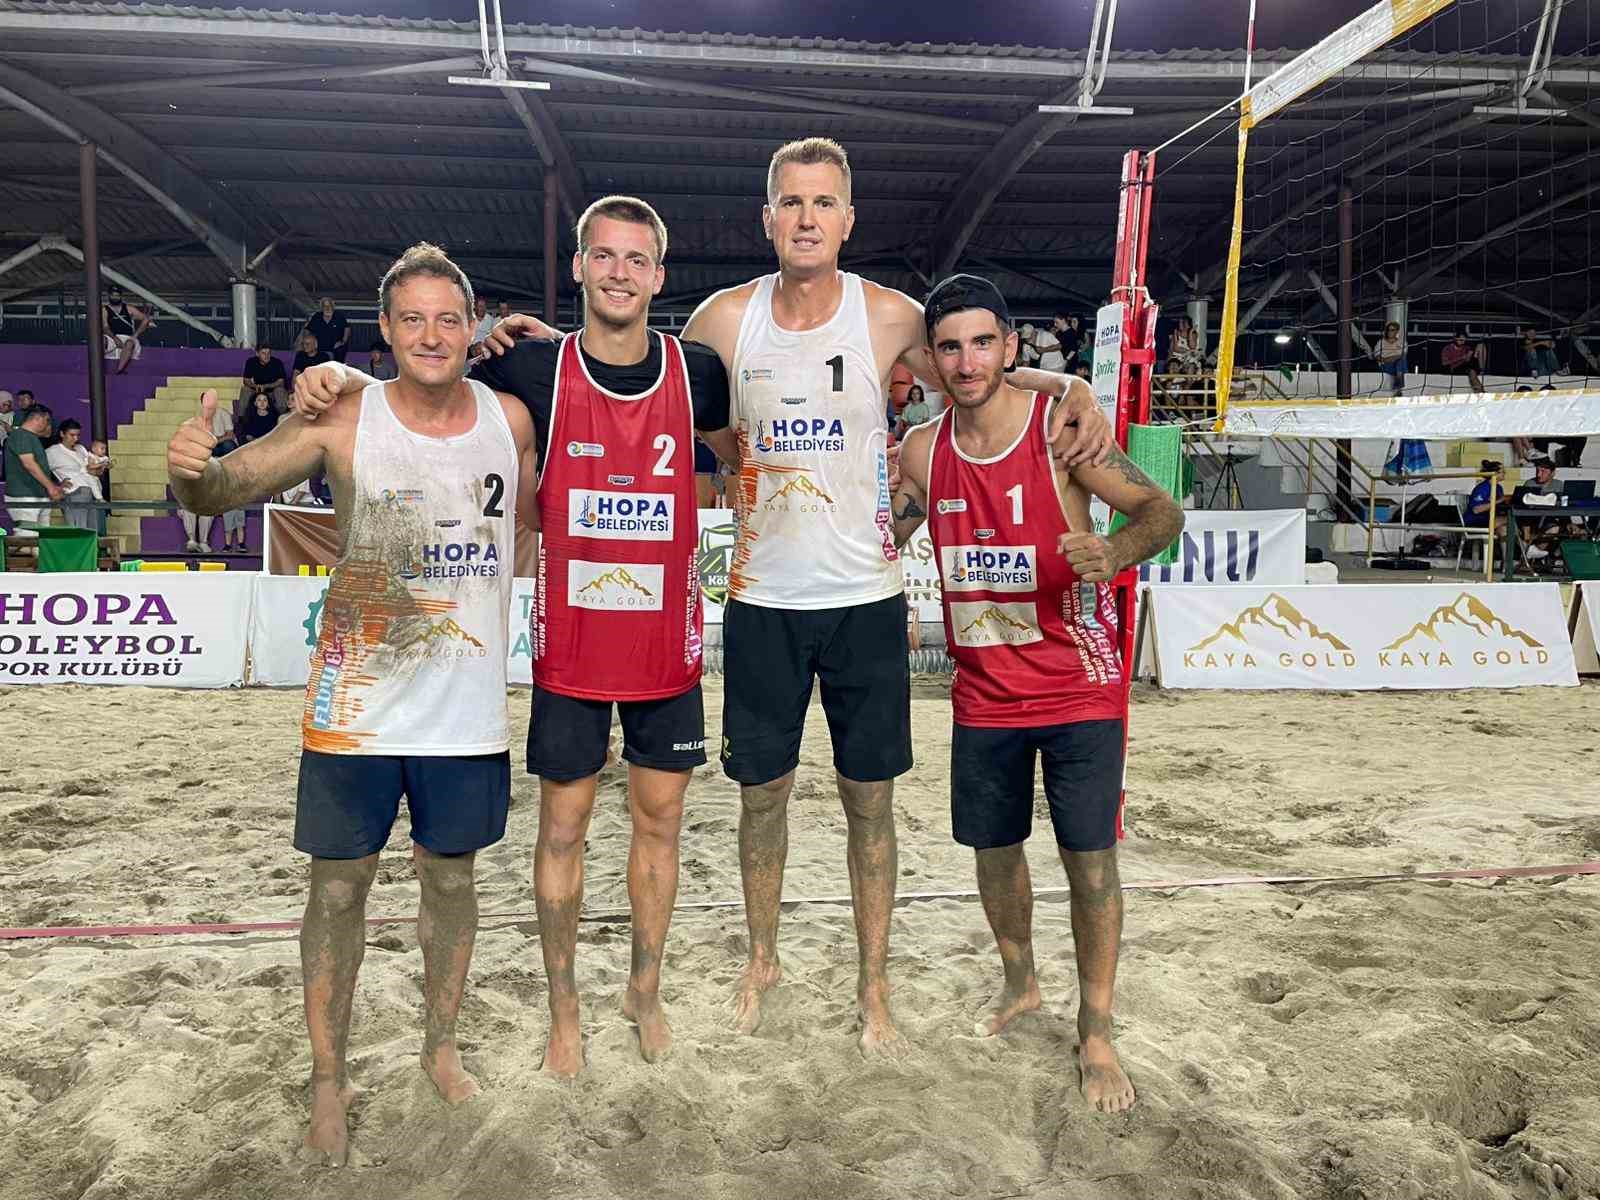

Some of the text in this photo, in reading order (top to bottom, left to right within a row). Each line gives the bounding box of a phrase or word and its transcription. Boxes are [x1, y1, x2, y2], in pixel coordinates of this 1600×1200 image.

[1101, 325, 1119, 338] HOPA
[826, 354, 844, 392] 1
[773, 419, 844, 438] HOPA
[652, 433, 676, 476] 2
[483, 473, 505, 518] 2
[1006, 484, 1024, 525] 1
[597, 497, 668, 517] HOPA
[800, 504, 838, 513] GOLD
[422, 543, 498, 563] HOPA
[966, 551, 1031, 569] HOPA
[0, 593, 178, 626] HOPA
[617, 595, 656, 606] GOLD
[57, 658, 184, 676] KULÜBÜ
[1183, 652, 1356, 668] KAYA GOLD
[1378, 650, 1549, 666] KAYA GOLD
